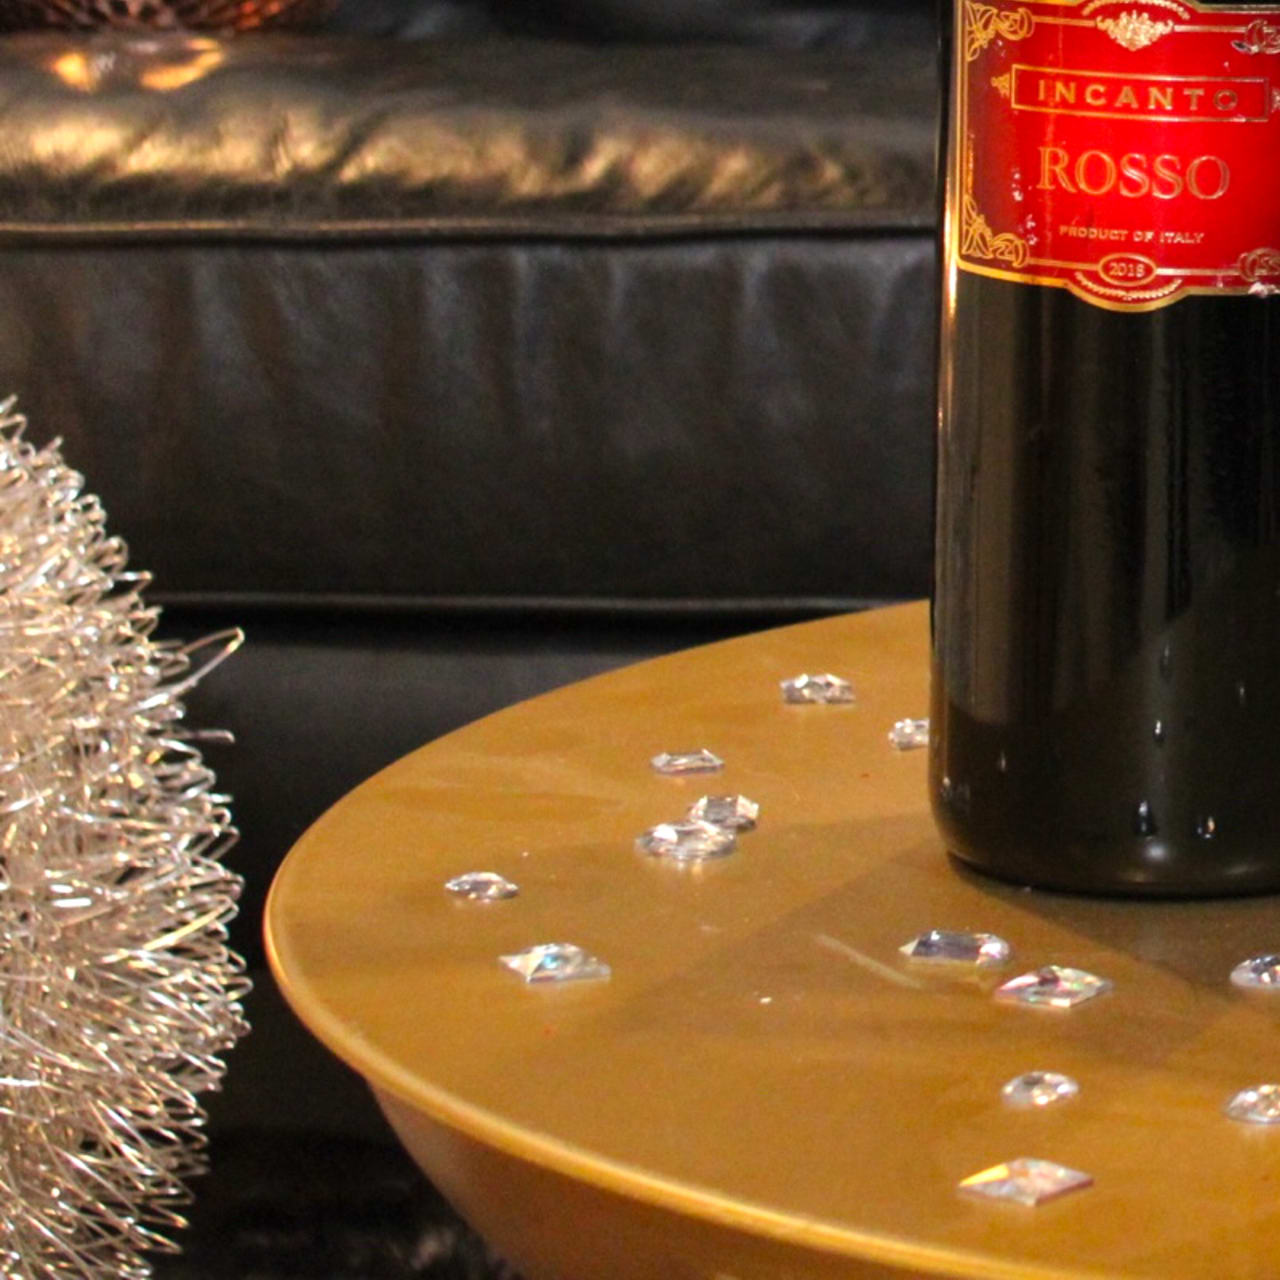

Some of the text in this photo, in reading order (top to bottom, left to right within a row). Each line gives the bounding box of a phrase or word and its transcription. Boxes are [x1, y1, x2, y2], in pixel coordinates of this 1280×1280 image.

[1037, 79, 1238, 111] INCANTO
[1036, 146, 1230, 200] ROSSO
[1059, 225, 1205, 244] PRODUCT OF ITALY
